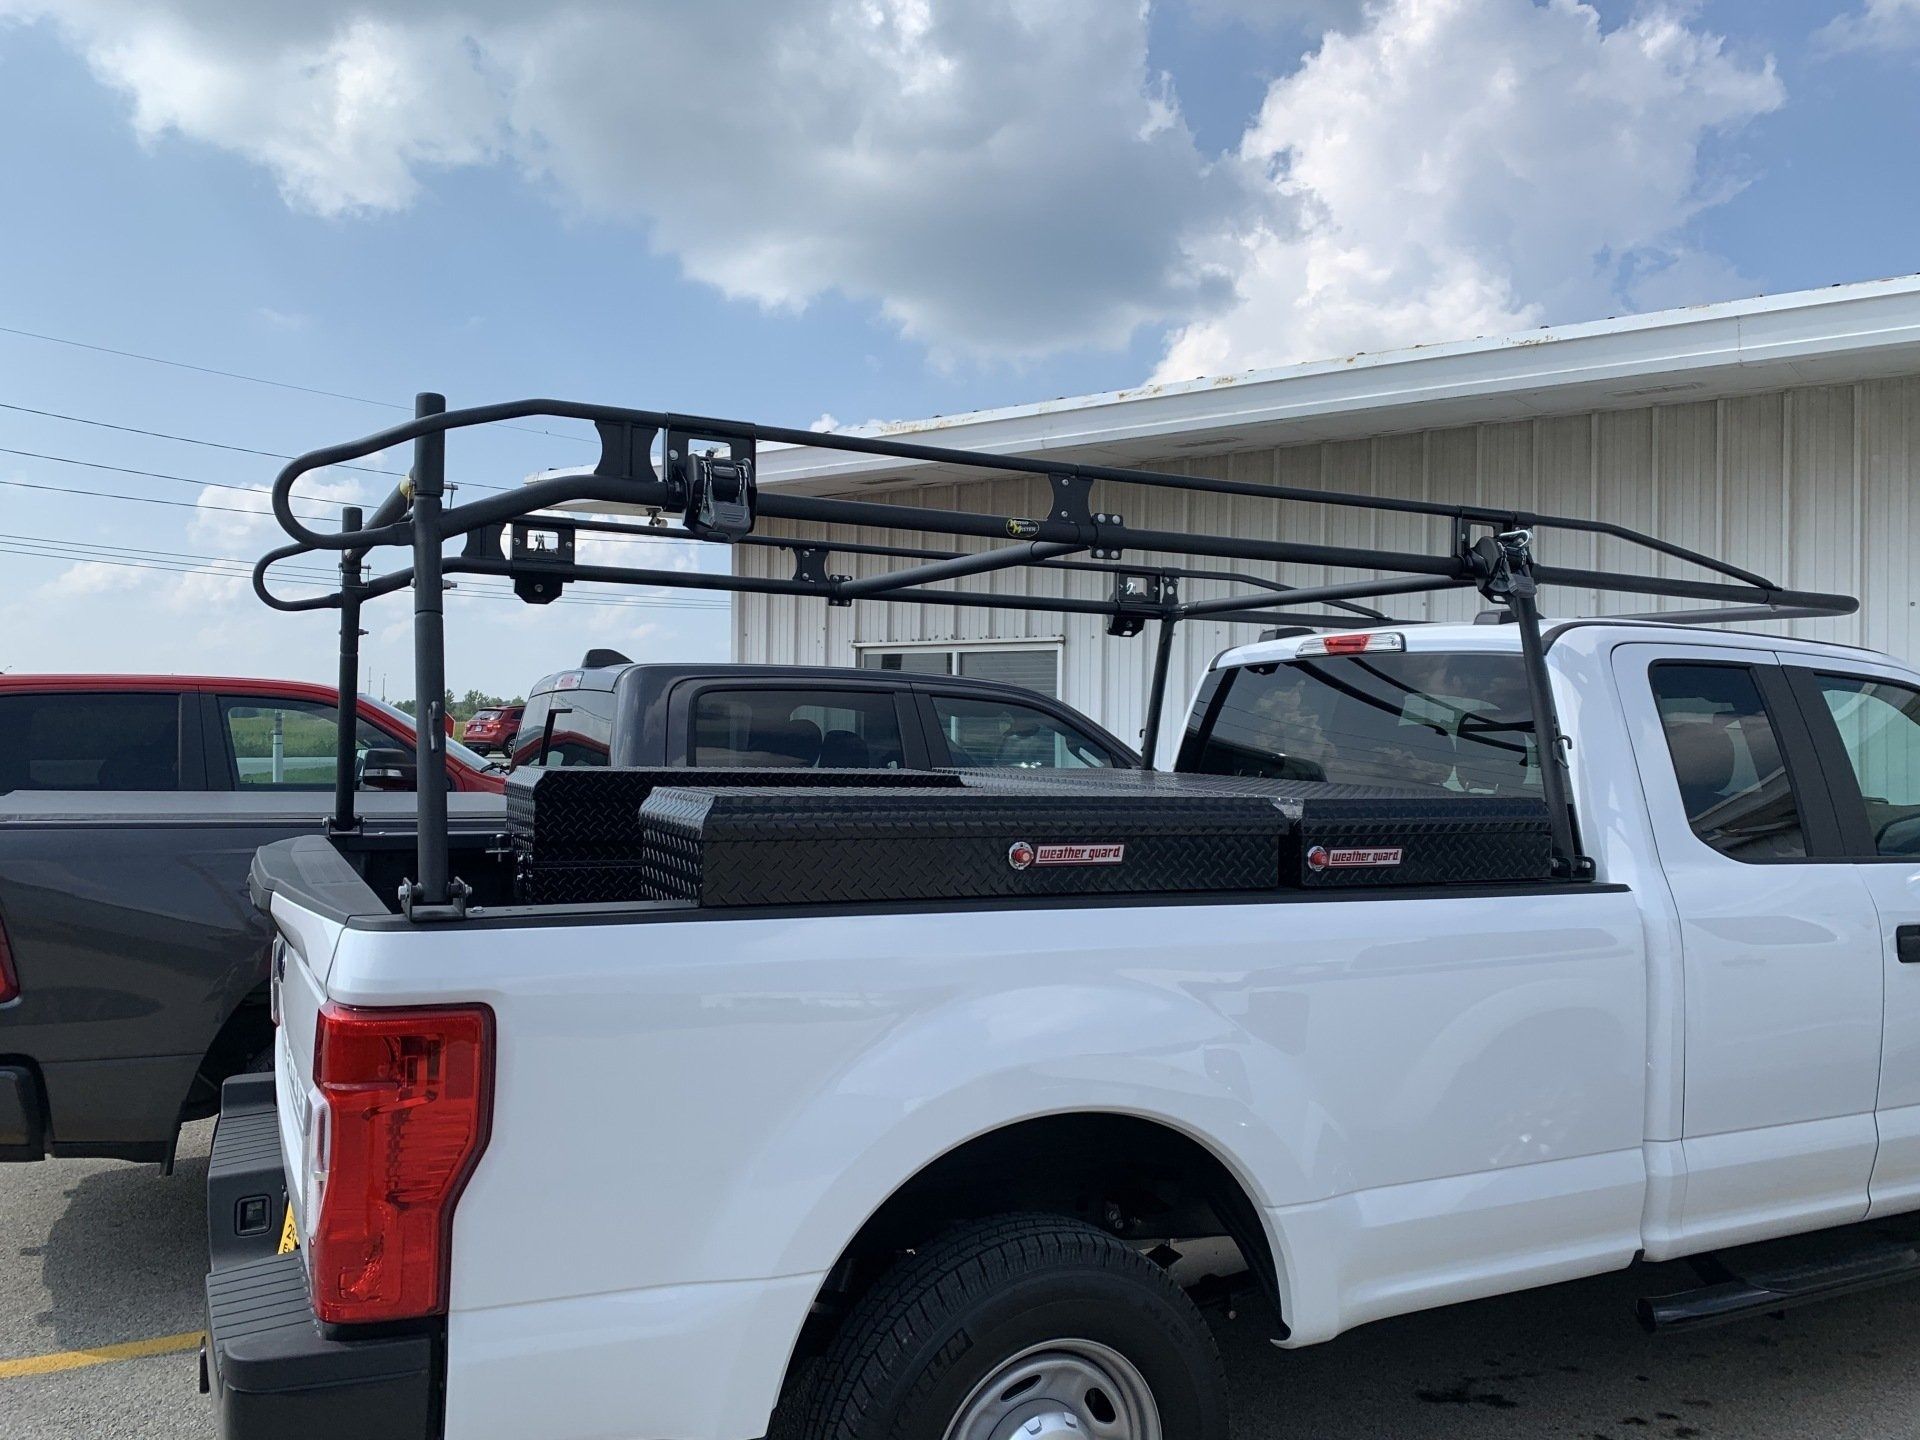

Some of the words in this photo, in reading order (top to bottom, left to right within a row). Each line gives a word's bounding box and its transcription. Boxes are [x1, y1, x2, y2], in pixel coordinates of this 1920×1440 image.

[1039, 847, 1087, 859] weather
[1088, 846, 1121, 861] guard
[1331, 851, 1371, 862] weather
[1372, 850, 1400, 863] guard
